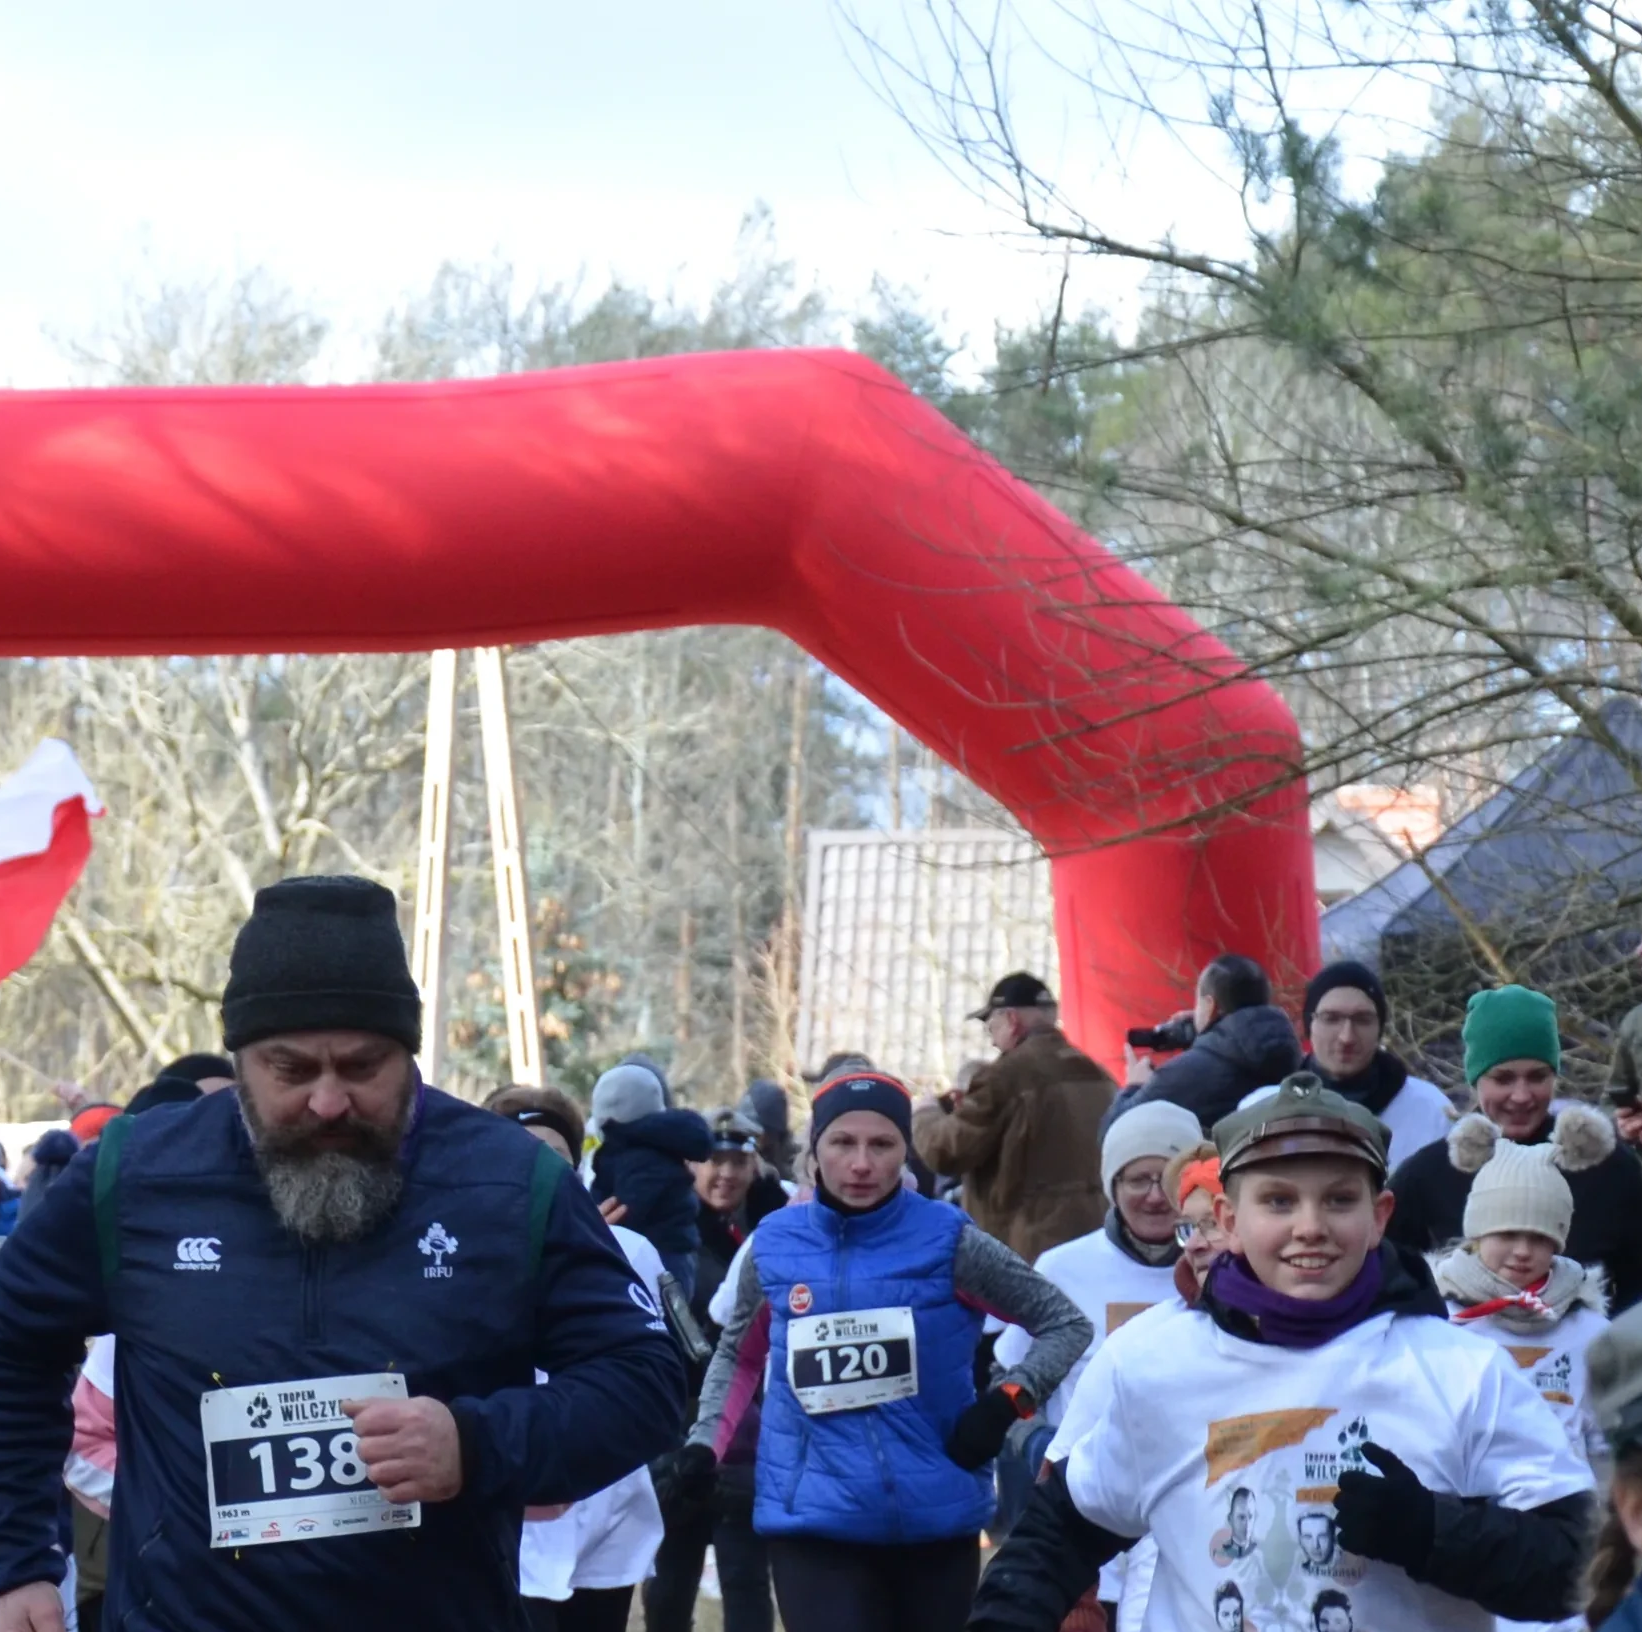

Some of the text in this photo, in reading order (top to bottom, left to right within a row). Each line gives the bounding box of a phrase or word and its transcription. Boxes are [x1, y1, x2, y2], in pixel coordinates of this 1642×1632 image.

[173, 1262, 222, 1272] canterbury
[423, 1266, 453, 1278] IRFU
[814, 1343, 889, 1383] 120
[277, 1390, 316, 1403] TROPEM
[249, 1432, 367, 1494] 138
